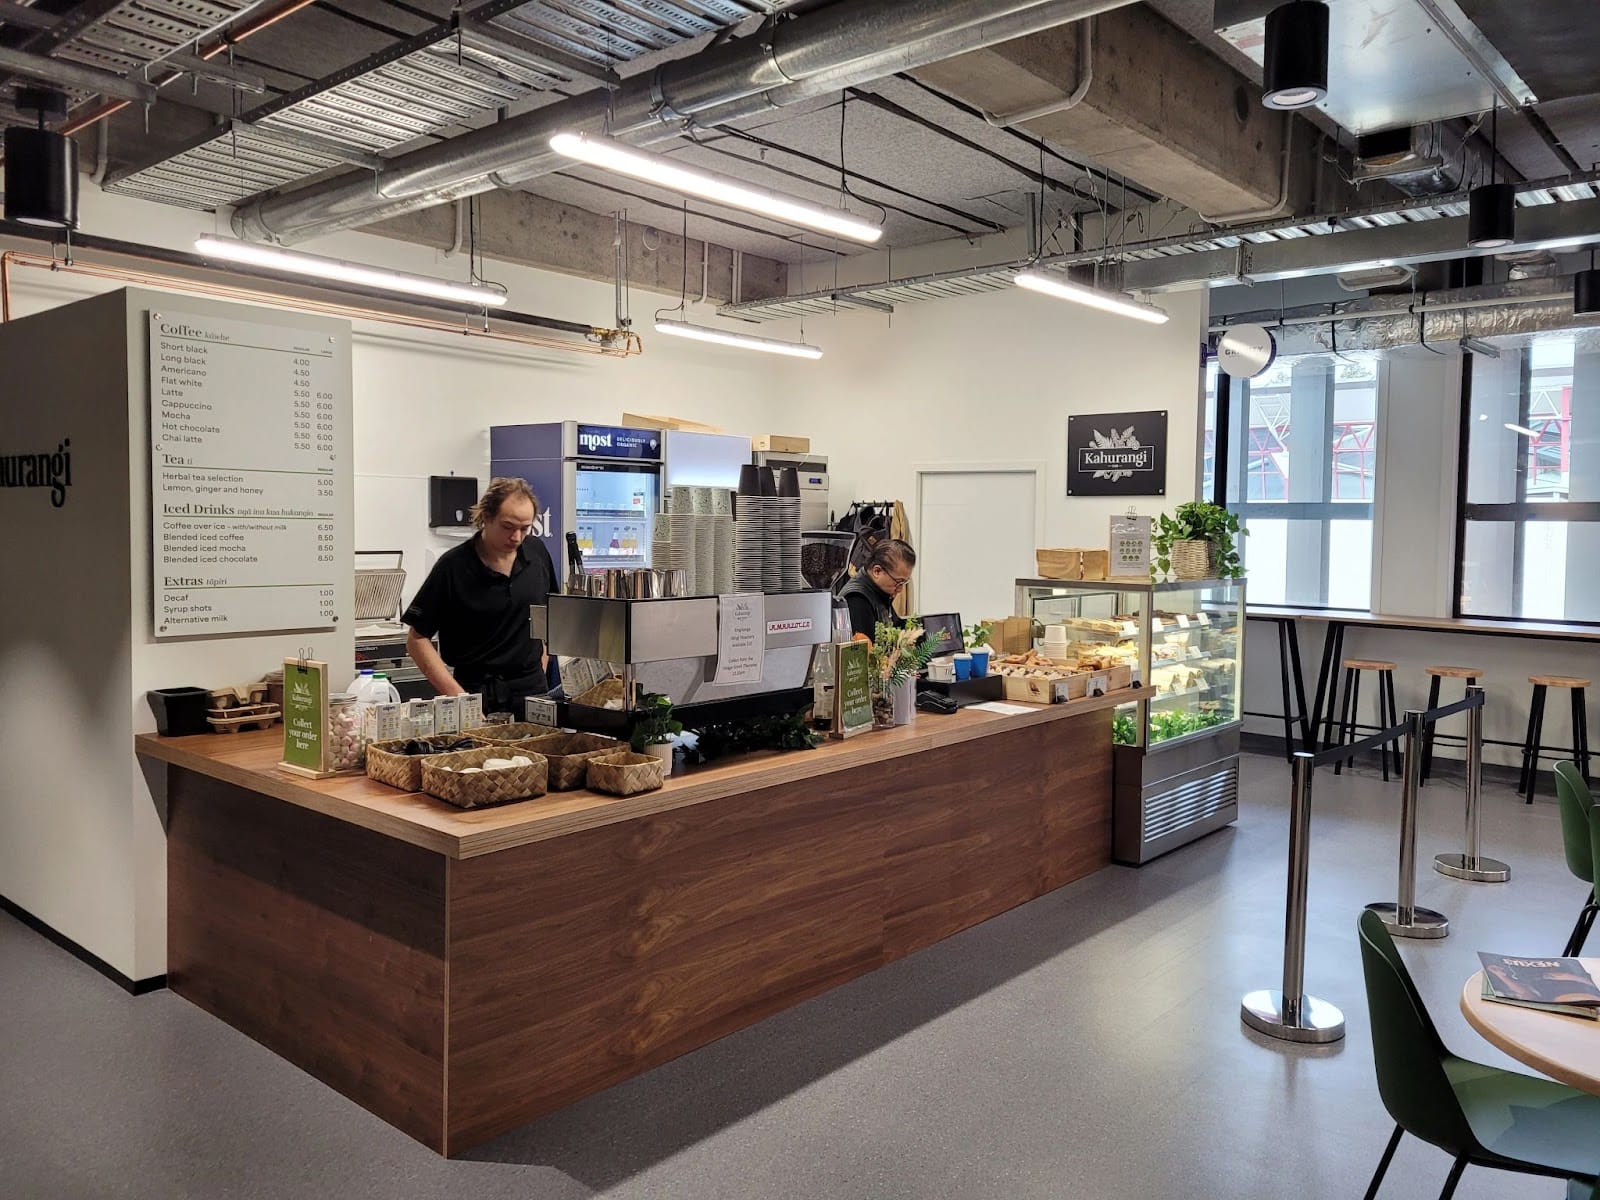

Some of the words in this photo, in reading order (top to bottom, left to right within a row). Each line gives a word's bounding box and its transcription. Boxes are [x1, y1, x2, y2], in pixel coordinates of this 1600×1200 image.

[160, 323, 202, 338] Coffee
[160, 341, 184, 352] Short
[186, 344, 208, 354] black
[293, 358, 310, 366] 4.00
[161, 354, 182, 364] Long
[184, 355, 206, 365] black
[293, 369, 310, 377] 4.50
[161, 365, 207, 377] Americano
[293, 380, 310, 388] 4.50
[161, 377, 177, 386] Flat
[179, 378, 202, 388] white
[294, 390, 310, 398] 5.50
[316, 392, 333, 400] 6.00
[162, 388, 184, 397] Latte
[316, 402, 333, 410] 6.00
[162, 400, 212, 412] Cappuccino
[162, 412, 191, 420] Mocha
[294, 422, 310, 430] 5.50
[316, 424, 333, 432] 6.00
[162, 423, 178, 432] Hot
[180, 424, 220, 434] chocolate
[294, 432, 310, 440] 5.50
[316, 434, 333, 442] 6.00
[162, 434, 182, 442] Chai
[183, 435, 202, 444] latte
[294, 442, 310, 450] 5.50
[316, 444, 333, 452] 6.00
[580, 433, 612, 452] most
[162, 454, 184, 465] Tea
[1084, 450, 1148, 468] Kahurangi
[162, 473, 191, 482] Herbal
[192, 474, 206, 482] tea
[208, 474, 244, 483] selection
[195, 486, 222, 494] ginger
[223, 486, 238, 494] and
[240, 486, 264, 496] honey
[163, 503, 190, 515] Iced
[194, 504, 235, 516] Drinks
[163, 522, 192, 531] Coffee
[194, 523, 212, 531] over
[213, 522, 226, 531] ice
[274, 524, 287, 532] milk
[318, 524, 334, 532] 6.50
[164, 534, 198, 542] Blended
[200, 534, 218, 542] iced
[219, 534, 245, 542] coffee
[318, 534, 334, 542] 8.50
[164, 544, 198, 552] Blended
[200, 544, 218, 552] iced
[219, 544, 246, 552] mocha
[164, 556, 198, 564] Blended
[200, 556, 218, 564] iced
[219, 555, 258, 563] chocolate
[164, 576, 204, 587] Extras
[164, 594, 189, 602] Decaf
[164, 606, 188, 614] Syrup
[190, 604, 212, 612] shots
[164, 616, 210, 625] Alternative
[211, 615, 228, 623] milk
[847, 688, 863, 698] Collect
[844, 700, 856, 710] your
[855, 695, 867, 704] order
[293, 718, 312, 729] Collect
[289, 729, 301, 738] your
[302, 730, 317, 741] order
[296, 738, 310, 750] here
